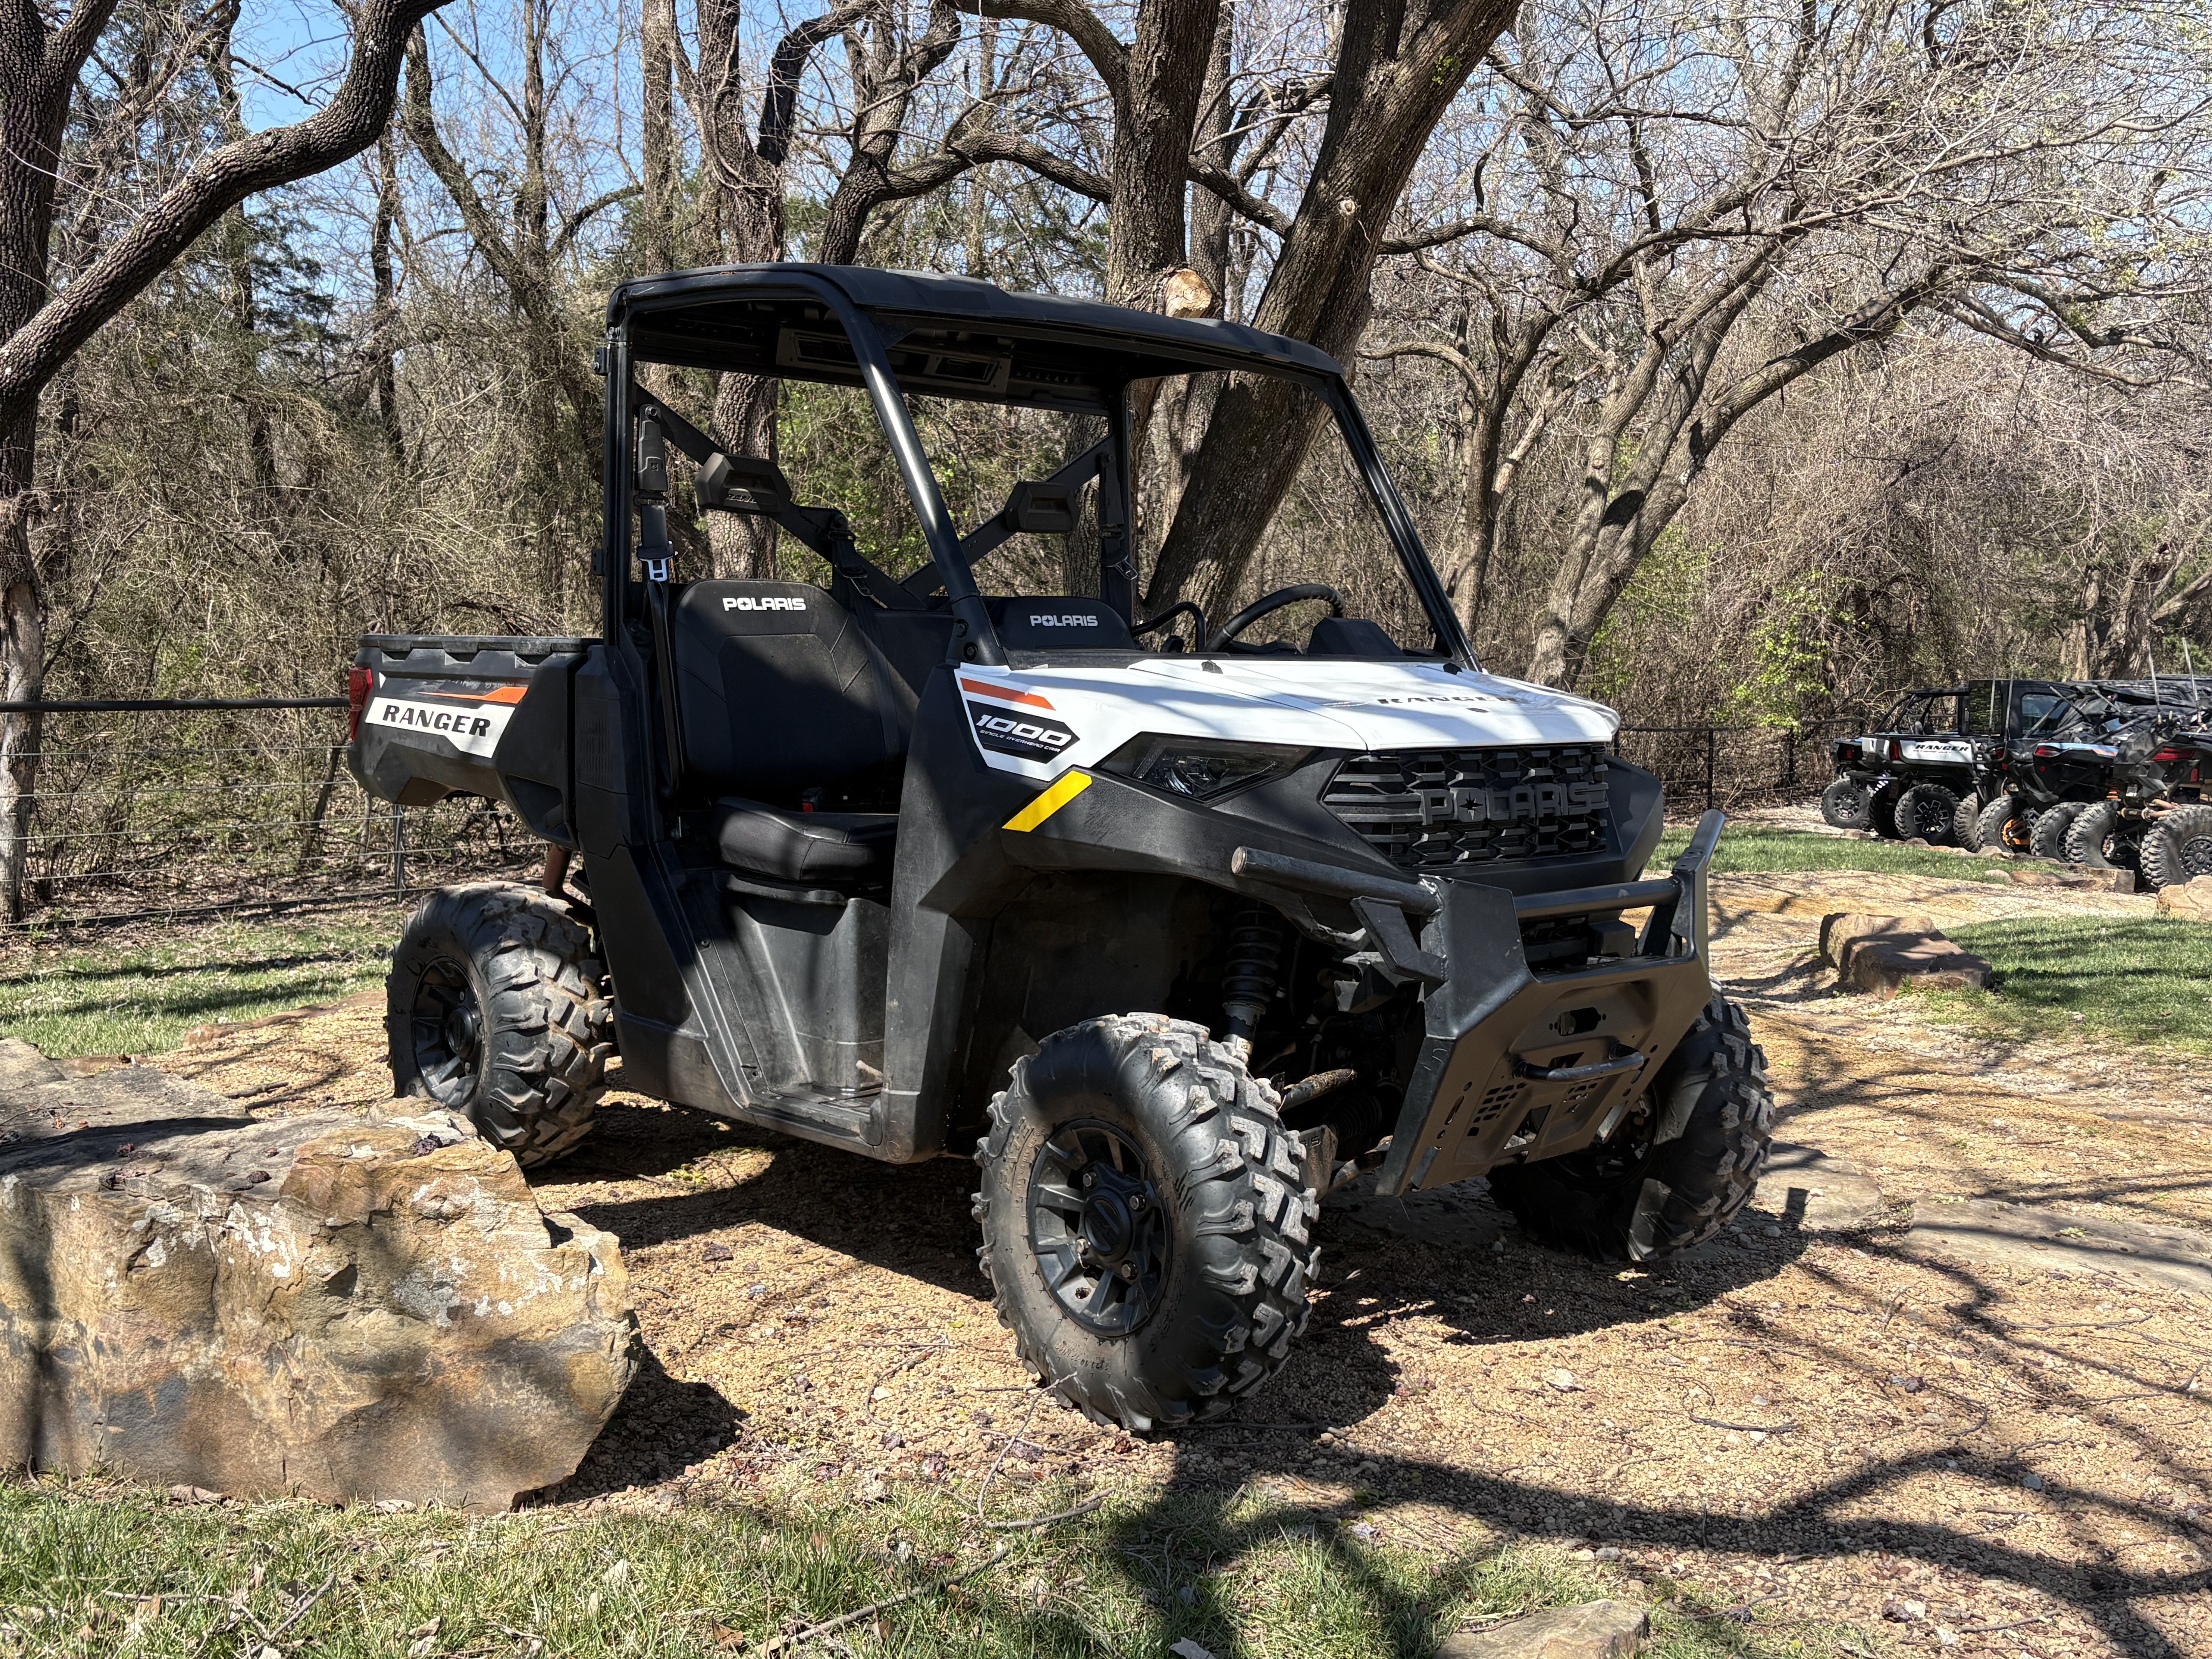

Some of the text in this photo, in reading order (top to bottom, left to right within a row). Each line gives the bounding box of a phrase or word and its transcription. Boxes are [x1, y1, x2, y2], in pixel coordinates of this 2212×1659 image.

[722, 597, 806, 611] POLARIS
[1029, 615, 1098, 626] POLARIS
[382, 705, 491, 737] RANGER
[976, 714, 1072, 746] 1000
[979, 730, 1006, 738] SINGLE
[1006, 736, 1044, 748] OVERHEAD
[1422, 782, 1592, 825] POLARIS
